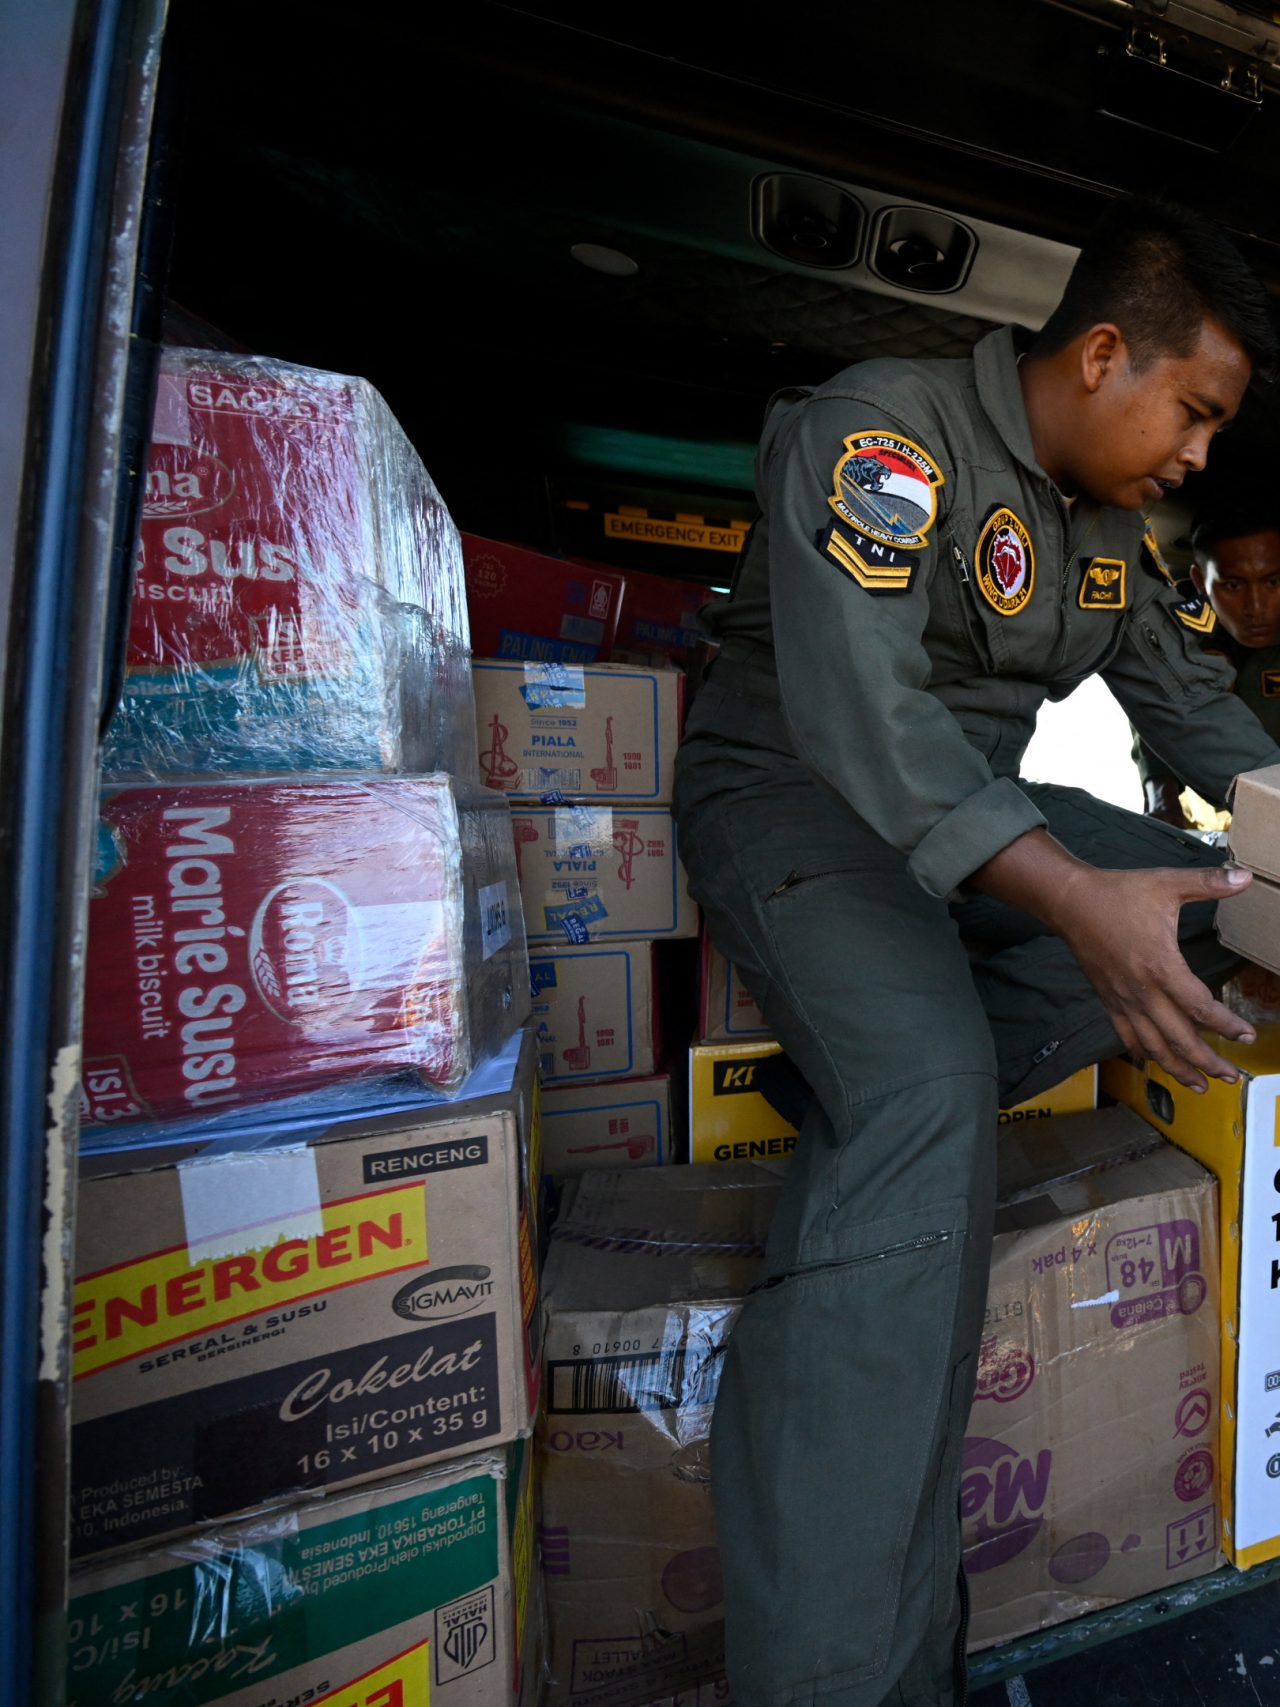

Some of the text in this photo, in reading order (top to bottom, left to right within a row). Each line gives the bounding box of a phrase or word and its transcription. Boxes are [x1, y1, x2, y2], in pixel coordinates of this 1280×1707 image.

[859, 437, 895, 448] EC-725
[901, 444, 934, 475] H-225M
[611, 518, 740, 548] EMERGENCY EXIT
[854, 533, 896, 563] TNI
[982, 574, 998, 601] WING
[998, 597, 1021, 610] UDARA
[502, 634, 554, 660] PALING
[530, 717, 556, 728] Since
[522, 749, 585, 760] INTERNATIONAL
[531, 735, 577, 748] PIALA
[553, 860, 597, 872] PIALA
[132, 895, 170, 1041] milk biscuit
[164, 806, 248, 1108] Marie Susu
[279, 901, 324, 1009] Roma
[87, 1068, 126, 1102] ISI
[370, 1144, 482, 1176] RENCENG
[714, 1136, 798, 1161] GENER
[1032, 1247, 1066, 1274] pak
[1072, 1248, 1083, 1264] 4
[1165, 1234, 1192, 1271] M
[1120, 1257, 1155, 1288] 48
[397, 1279, 495, 1315] SIGMAVIT
[1118, 1298, 1164, 1317] Celana
[138, 1299, 328, 1374] SEREAL & SUSU
[196, 1326, 287, 1363] BERSINERGI
[572, 1344, 581, 1356] 8
[593, 1339, 641, 1356] 00610
[278, 1338, 483, 1422] Cokelat
[325, 1386, 487, 1443] Isi/Content:
[298, 1408, 489, 1476] 16 x 10 x 35 g
[79, 1474, 204, 1521] EKA SEMESTA
[80, 1468, 158, 1503] Produced
[103, 1498, 190, 1532] Indonesia.
[420, 1491, 486, 1522] Tangerang
[288, 1505, 486, 1582] PT TORABIKA EKA SEMEST
[298, 1527, 373, 1562] Indonesia.
[419, 1519, 487, 1553] Diproduksi
[322, 1544, 420, 1589] oleh/Produced
[149, 1587, 188, 1613] 16
[442, 1603, 488, 1629] HALAL
[68, 1627, 152, 1672] Isi/C
[591, 1649, 649, 1665] ALLET
[111, 1634, 276, 1706] Kacang
